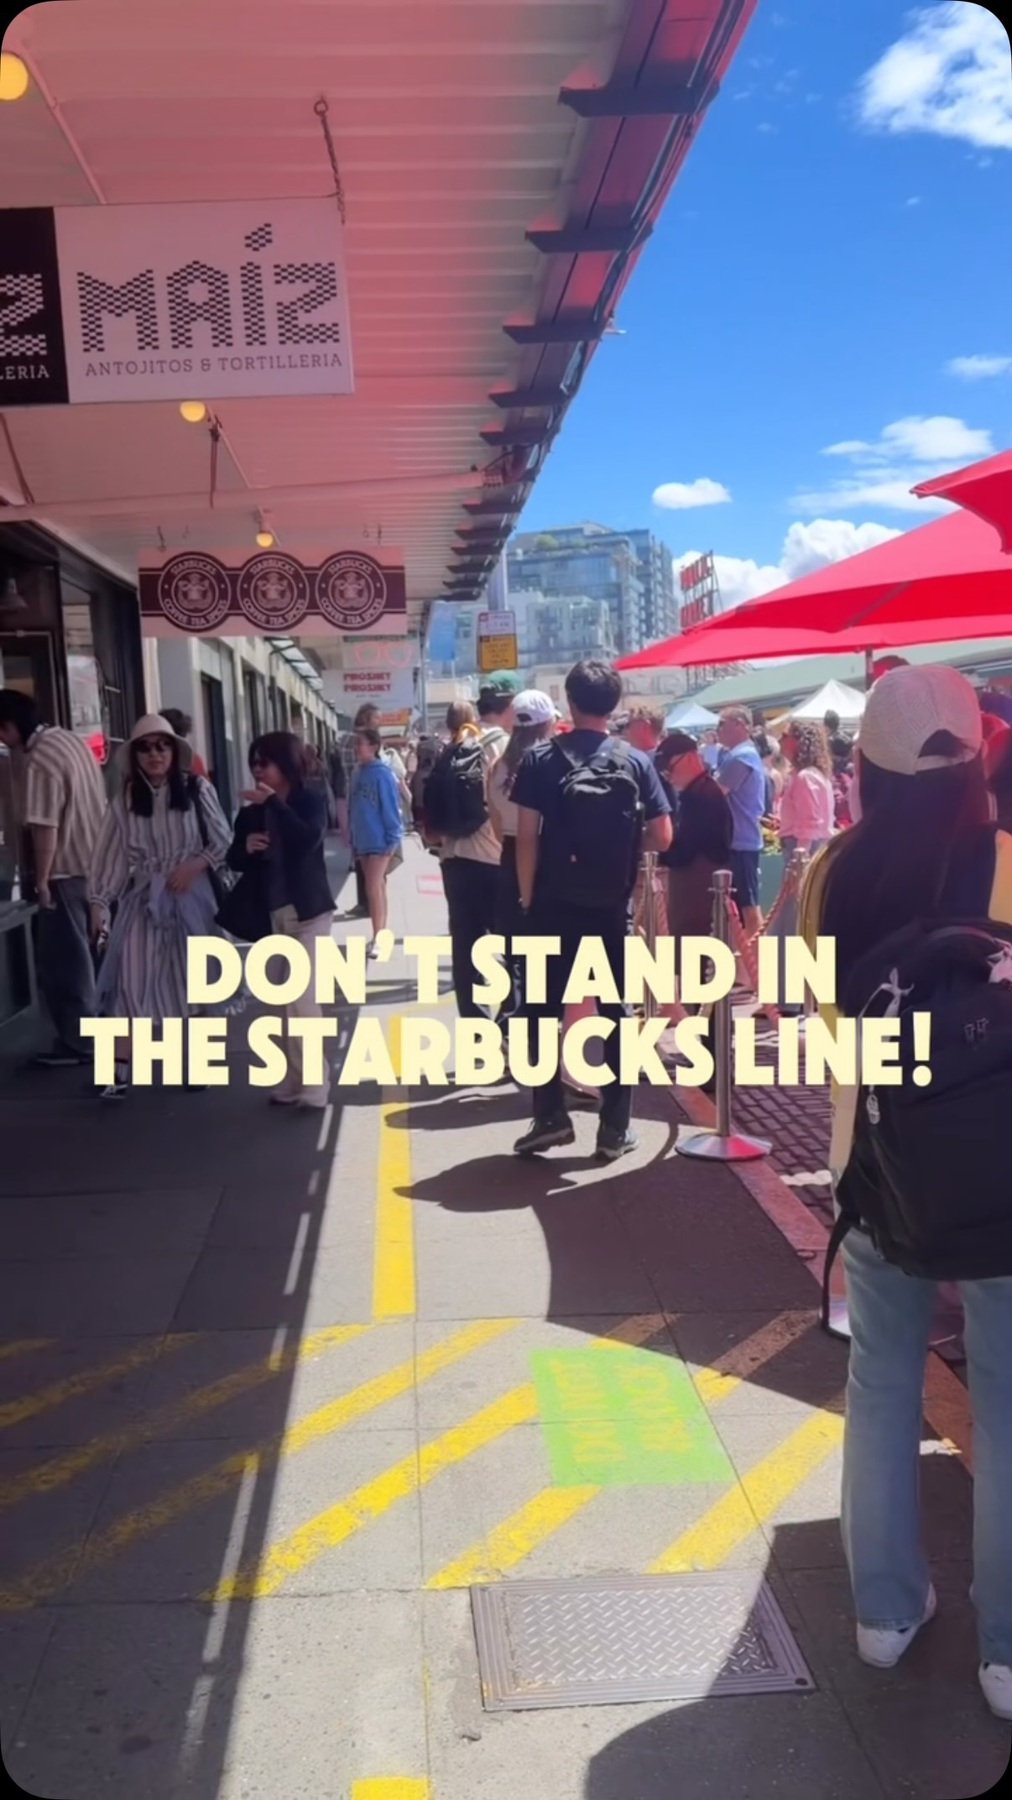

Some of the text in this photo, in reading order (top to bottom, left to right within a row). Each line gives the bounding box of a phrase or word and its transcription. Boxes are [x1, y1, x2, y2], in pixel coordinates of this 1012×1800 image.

[77, 222, 341, 352] MAÍZ
[85, 353, 343, 377] ANTOJITOS & TORTILLERIA
[170, 560, 217, 575] STARBUCKS
[249, 559, 296, 575] STARBUCKS
[327, 558, 374, 575] STARBUCKS
[163, 598, 189, 624] COFFEE
[190, 616, 207, 626] TEA
[242, 598, 268, 624] COFFEE
[269, 615, 287, 625] TEA
[321, 597, 346, 623] COFFEE
[346, 614, 364, 625] TEA
